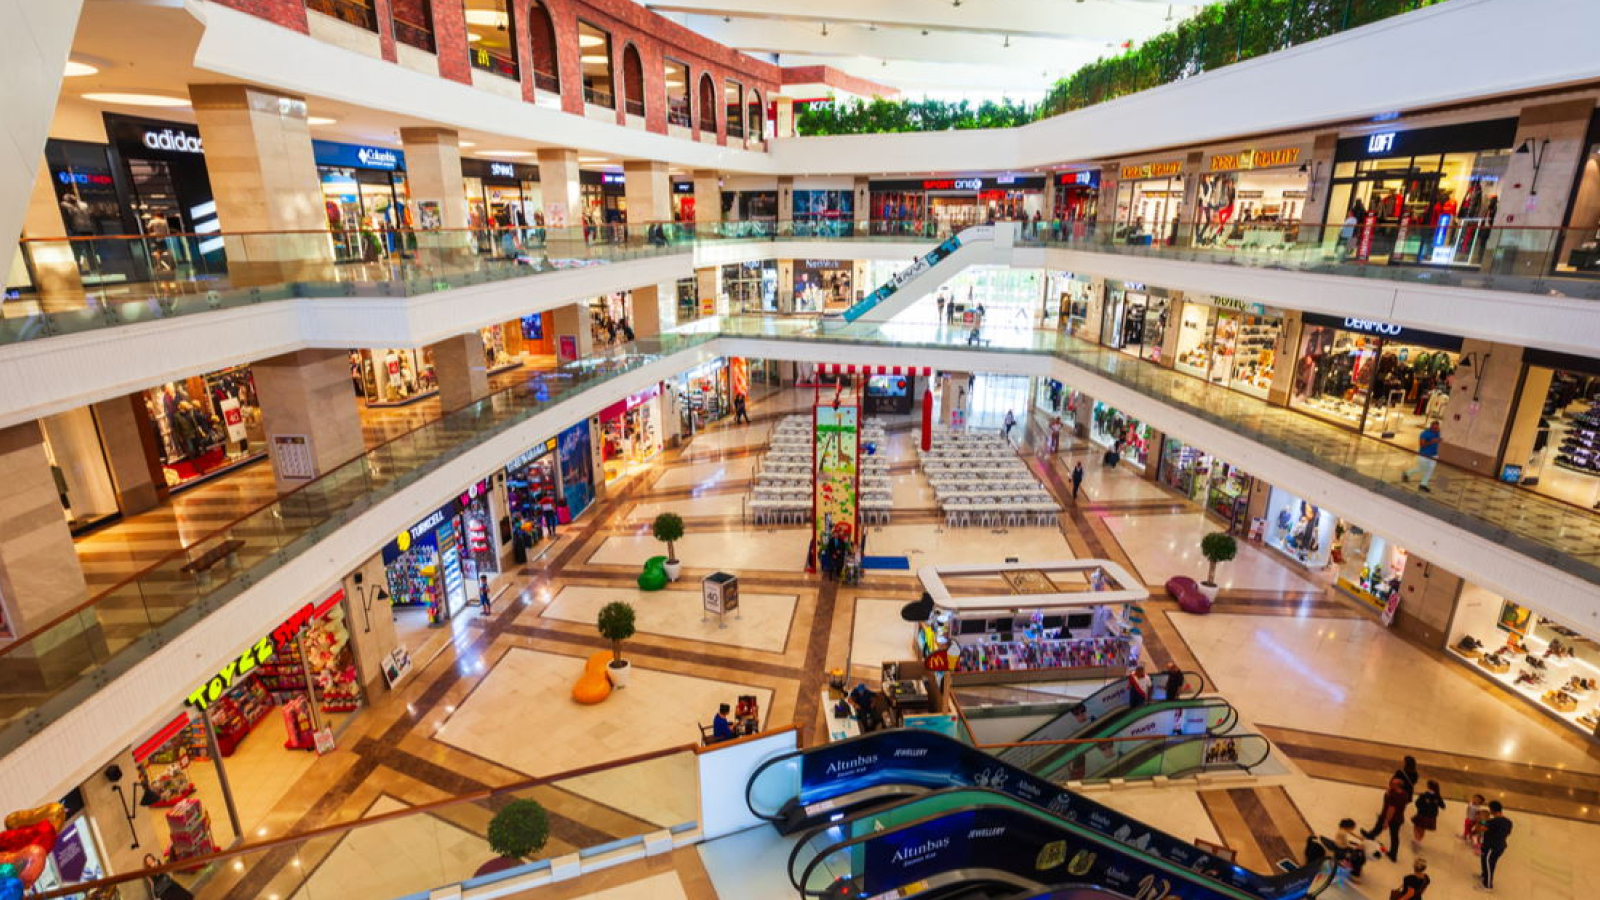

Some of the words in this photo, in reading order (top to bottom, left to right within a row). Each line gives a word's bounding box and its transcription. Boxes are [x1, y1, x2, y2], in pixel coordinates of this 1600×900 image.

[1368, 132, 1396, 153] LOFT
[410, 511, 445, 540] TURKCELL
[187, 635, 273, 709] TOYZZ
